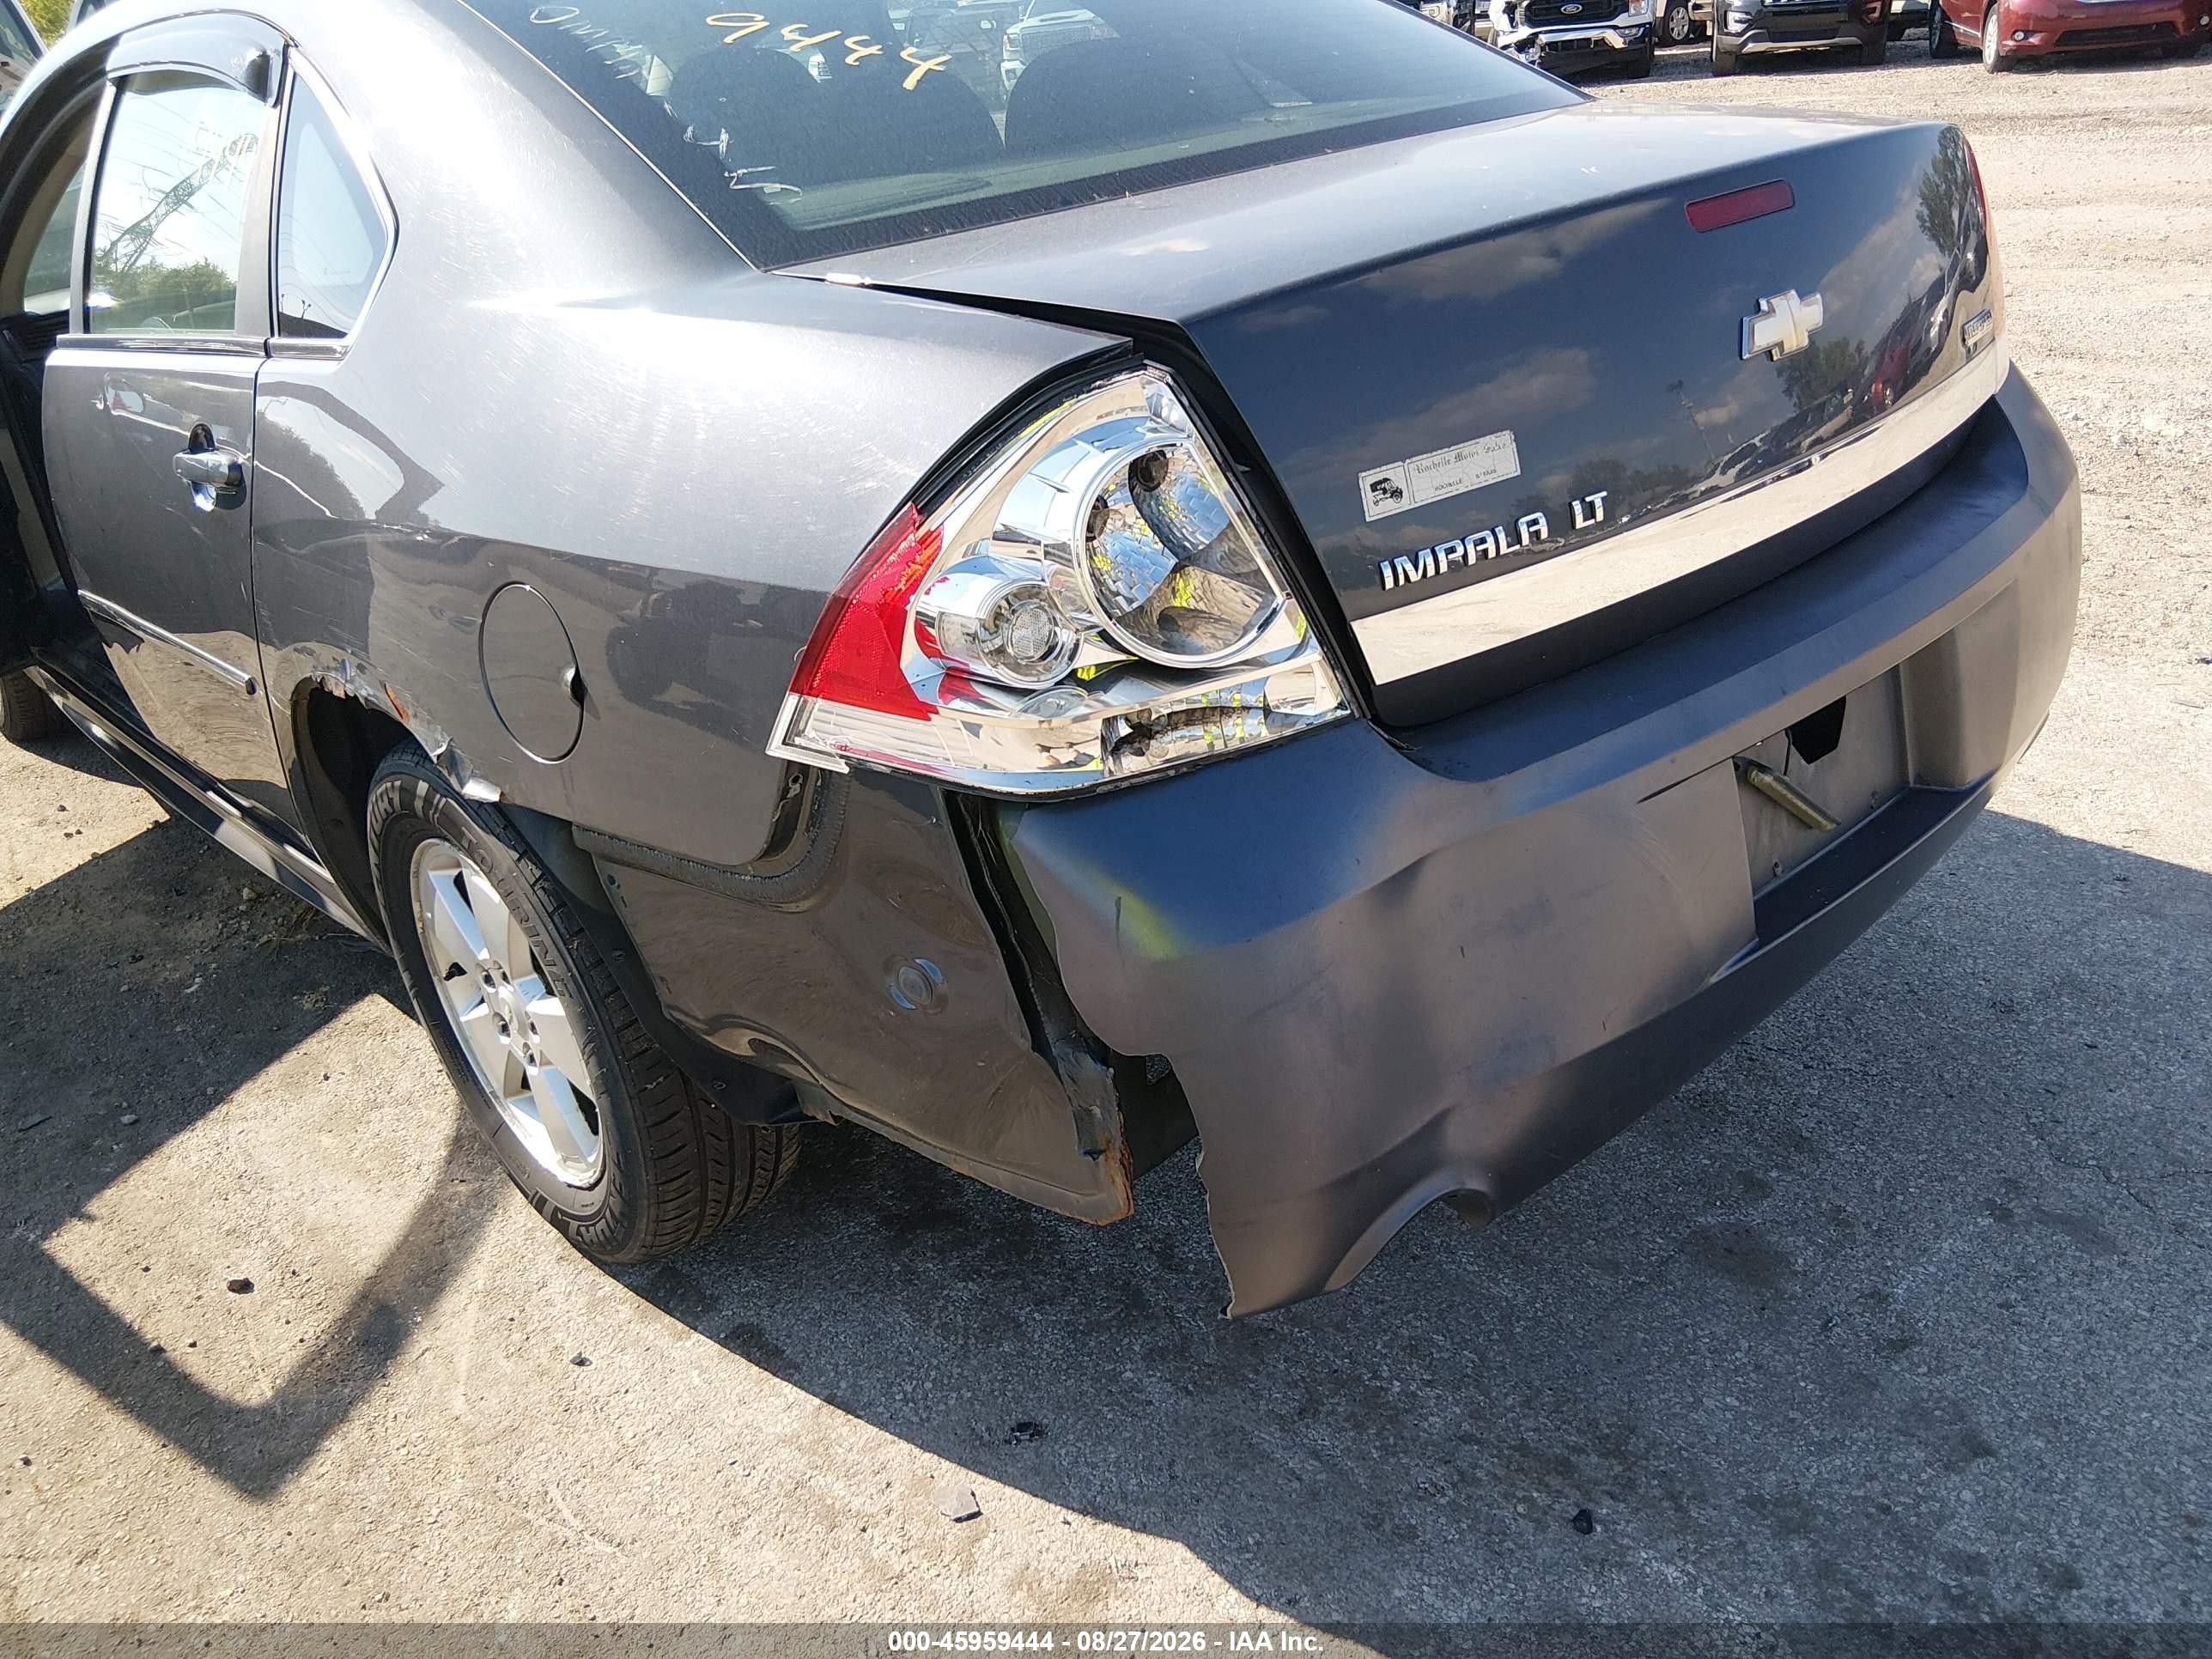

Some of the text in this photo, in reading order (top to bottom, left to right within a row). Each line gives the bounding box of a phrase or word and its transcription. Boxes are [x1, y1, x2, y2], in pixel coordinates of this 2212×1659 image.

[1379, 490, 1607, 591] IMPALA LT
[461, 826, 574, 1000] TOURING
